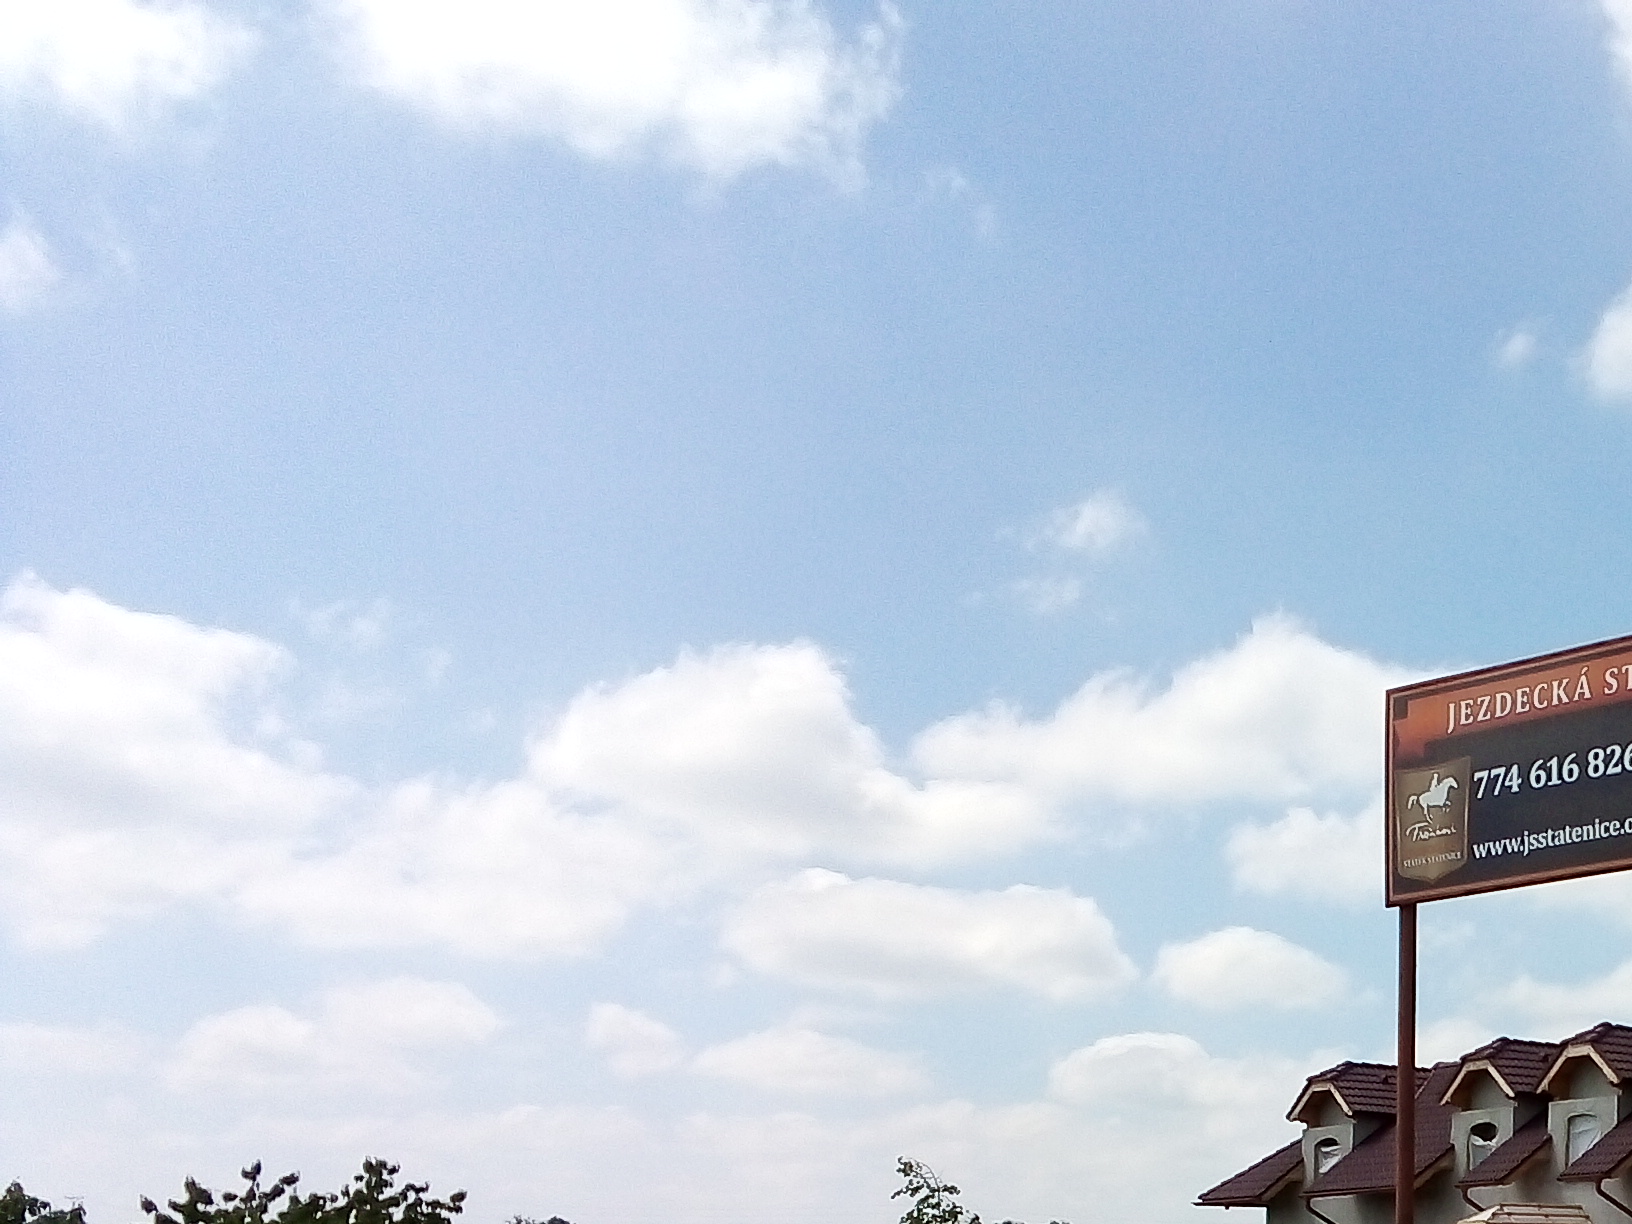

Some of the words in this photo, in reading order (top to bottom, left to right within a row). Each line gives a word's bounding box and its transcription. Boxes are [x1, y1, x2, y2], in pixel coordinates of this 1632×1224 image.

[1447, 666, 1591, 733] JEZDECKÁ
[1473, 764, 1522, 799] 774
[1529, 753, 1580, 789] 616
